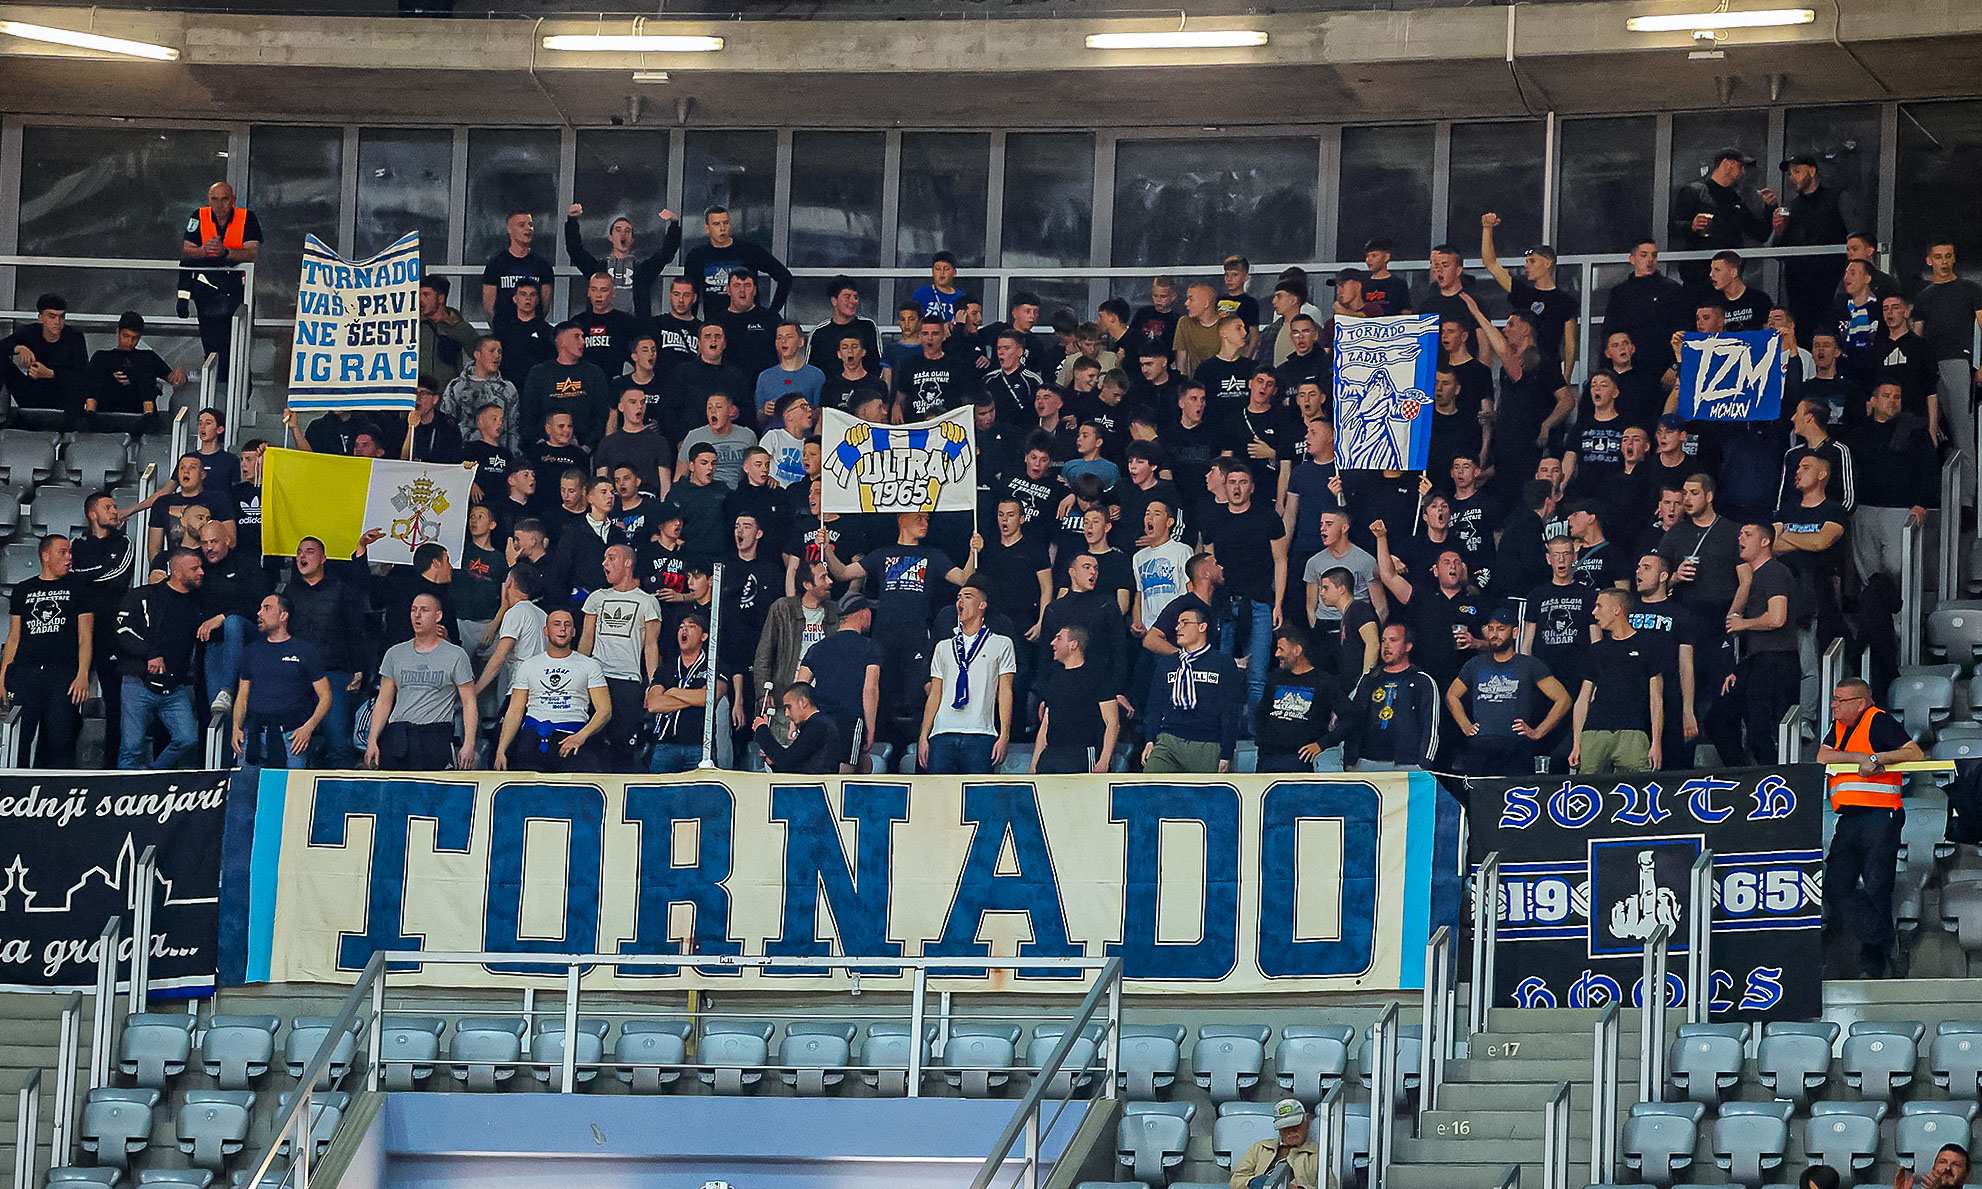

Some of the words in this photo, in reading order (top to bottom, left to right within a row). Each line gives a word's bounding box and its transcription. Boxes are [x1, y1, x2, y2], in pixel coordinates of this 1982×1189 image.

[302, 257, 420, 289] TORNADO
[300, 289, 345, 316] VAŠ
[357, 290, 417, 317] PRVI
[295, 320, 338, 347] NE
[347, 318, 418, 347] ŠESTI
[585, 335, 610, 348] DIESEL
[1347, 325, 1406, 340] TORNADO
[294, 345, 418, 382] IGRAČ
[1348, 352, 1388, 363] ZADAR
[860, 448, 948, 485] ULTRA
[0, 785, 88, 827] ednji
[96, 779, 227, 824] sanjari
[1498, 774, 1798, 829] SOUTH
[306, 775, 1383, 982] TORNADO
[1504, 876, 1574, 924] 19
[1720, 866, 1802, 918] 65
